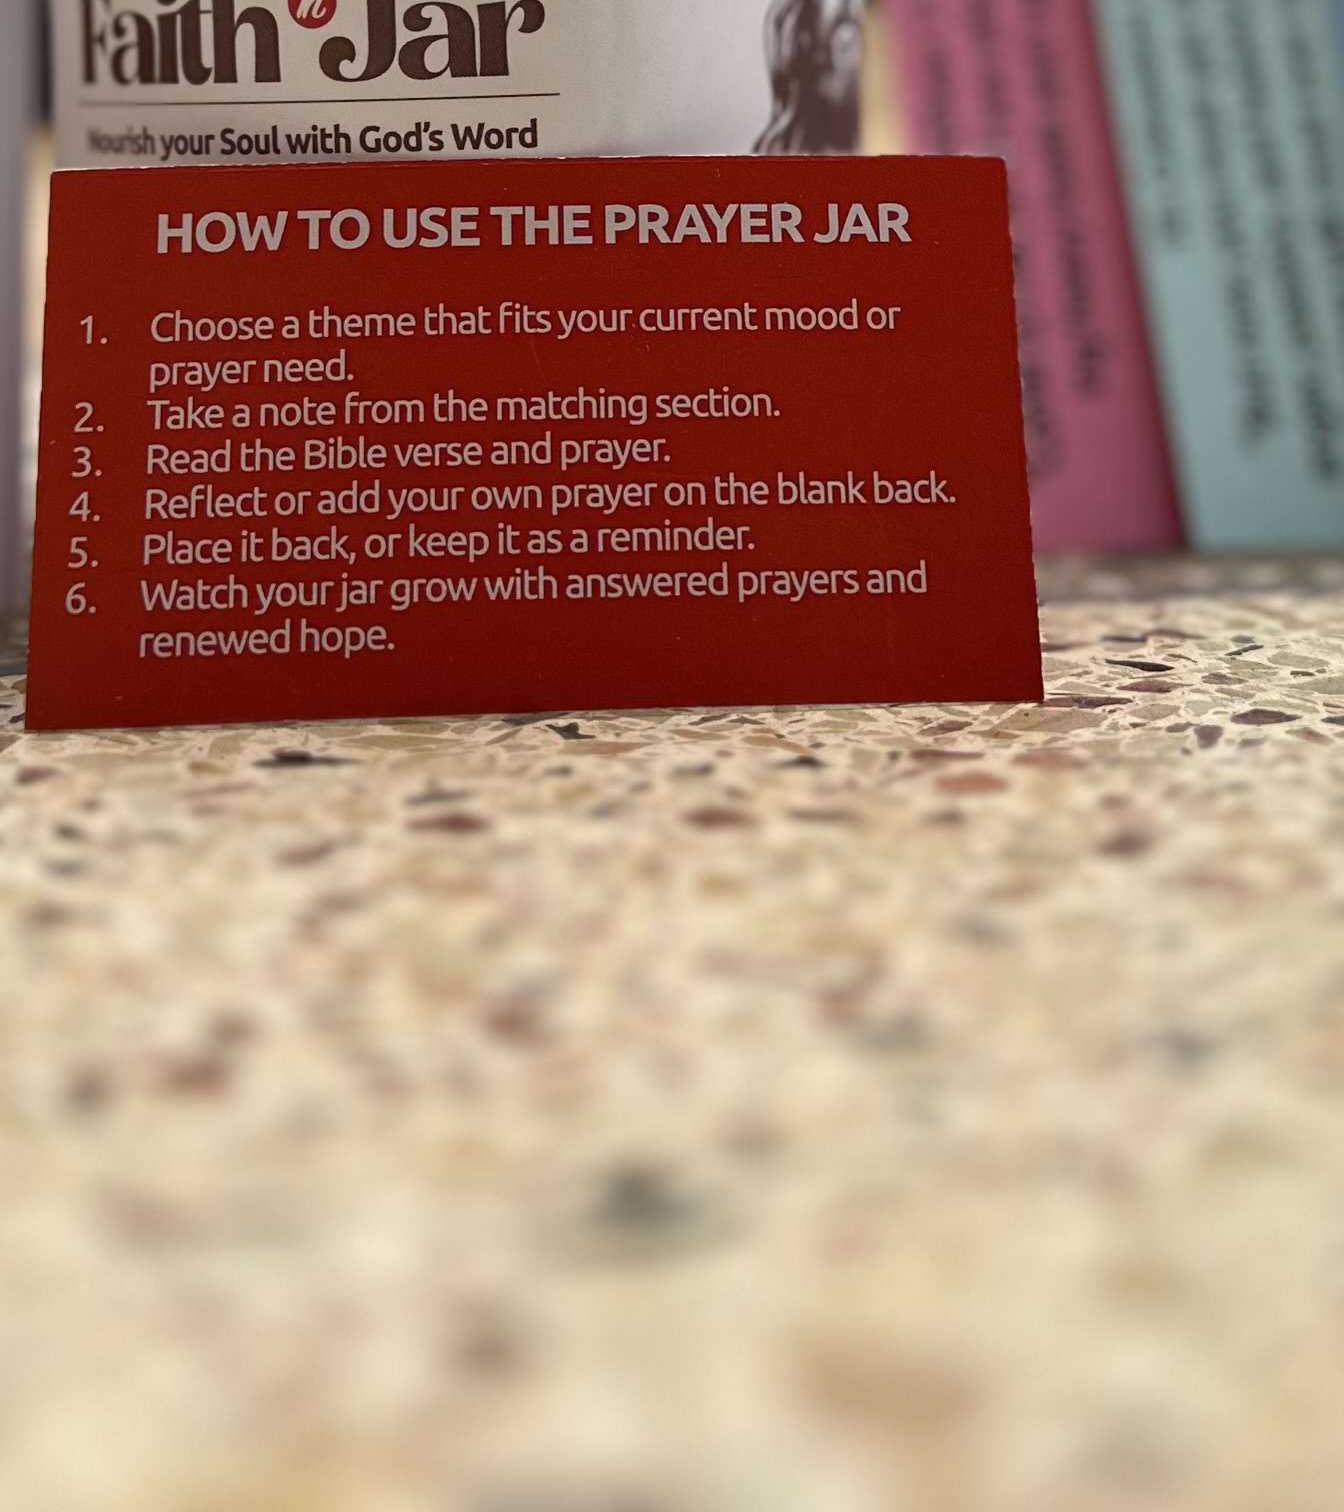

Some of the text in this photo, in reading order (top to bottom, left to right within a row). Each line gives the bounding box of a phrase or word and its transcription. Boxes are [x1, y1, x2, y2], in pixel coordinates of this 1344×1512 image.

[87, 118, 538, 161] Nourish your Soul with God's Word
[157, 201, 913, 254] HOW TO USE THE PRAYER JAR
[80, 297, 902, 345] 1. Choose a theme that fits your current mood or
[149, 348, 354, 394] prayer need.
[73, 385, 781, 433] 2. Take a note from the matching section.
[71, 430, 671, 478] 3. Read the Bible verse and prayer.
[69, 470, 956, 522] 4. Reflect or add your own prayer on the blank back.
[68, 516, 755, 568] 5. Place it back, or keep it as a reminder.
[65, 559, 927, 615] 6. Watch your jar grow with answered prayers and
[139, 618, 395, 659] renewed hope.
